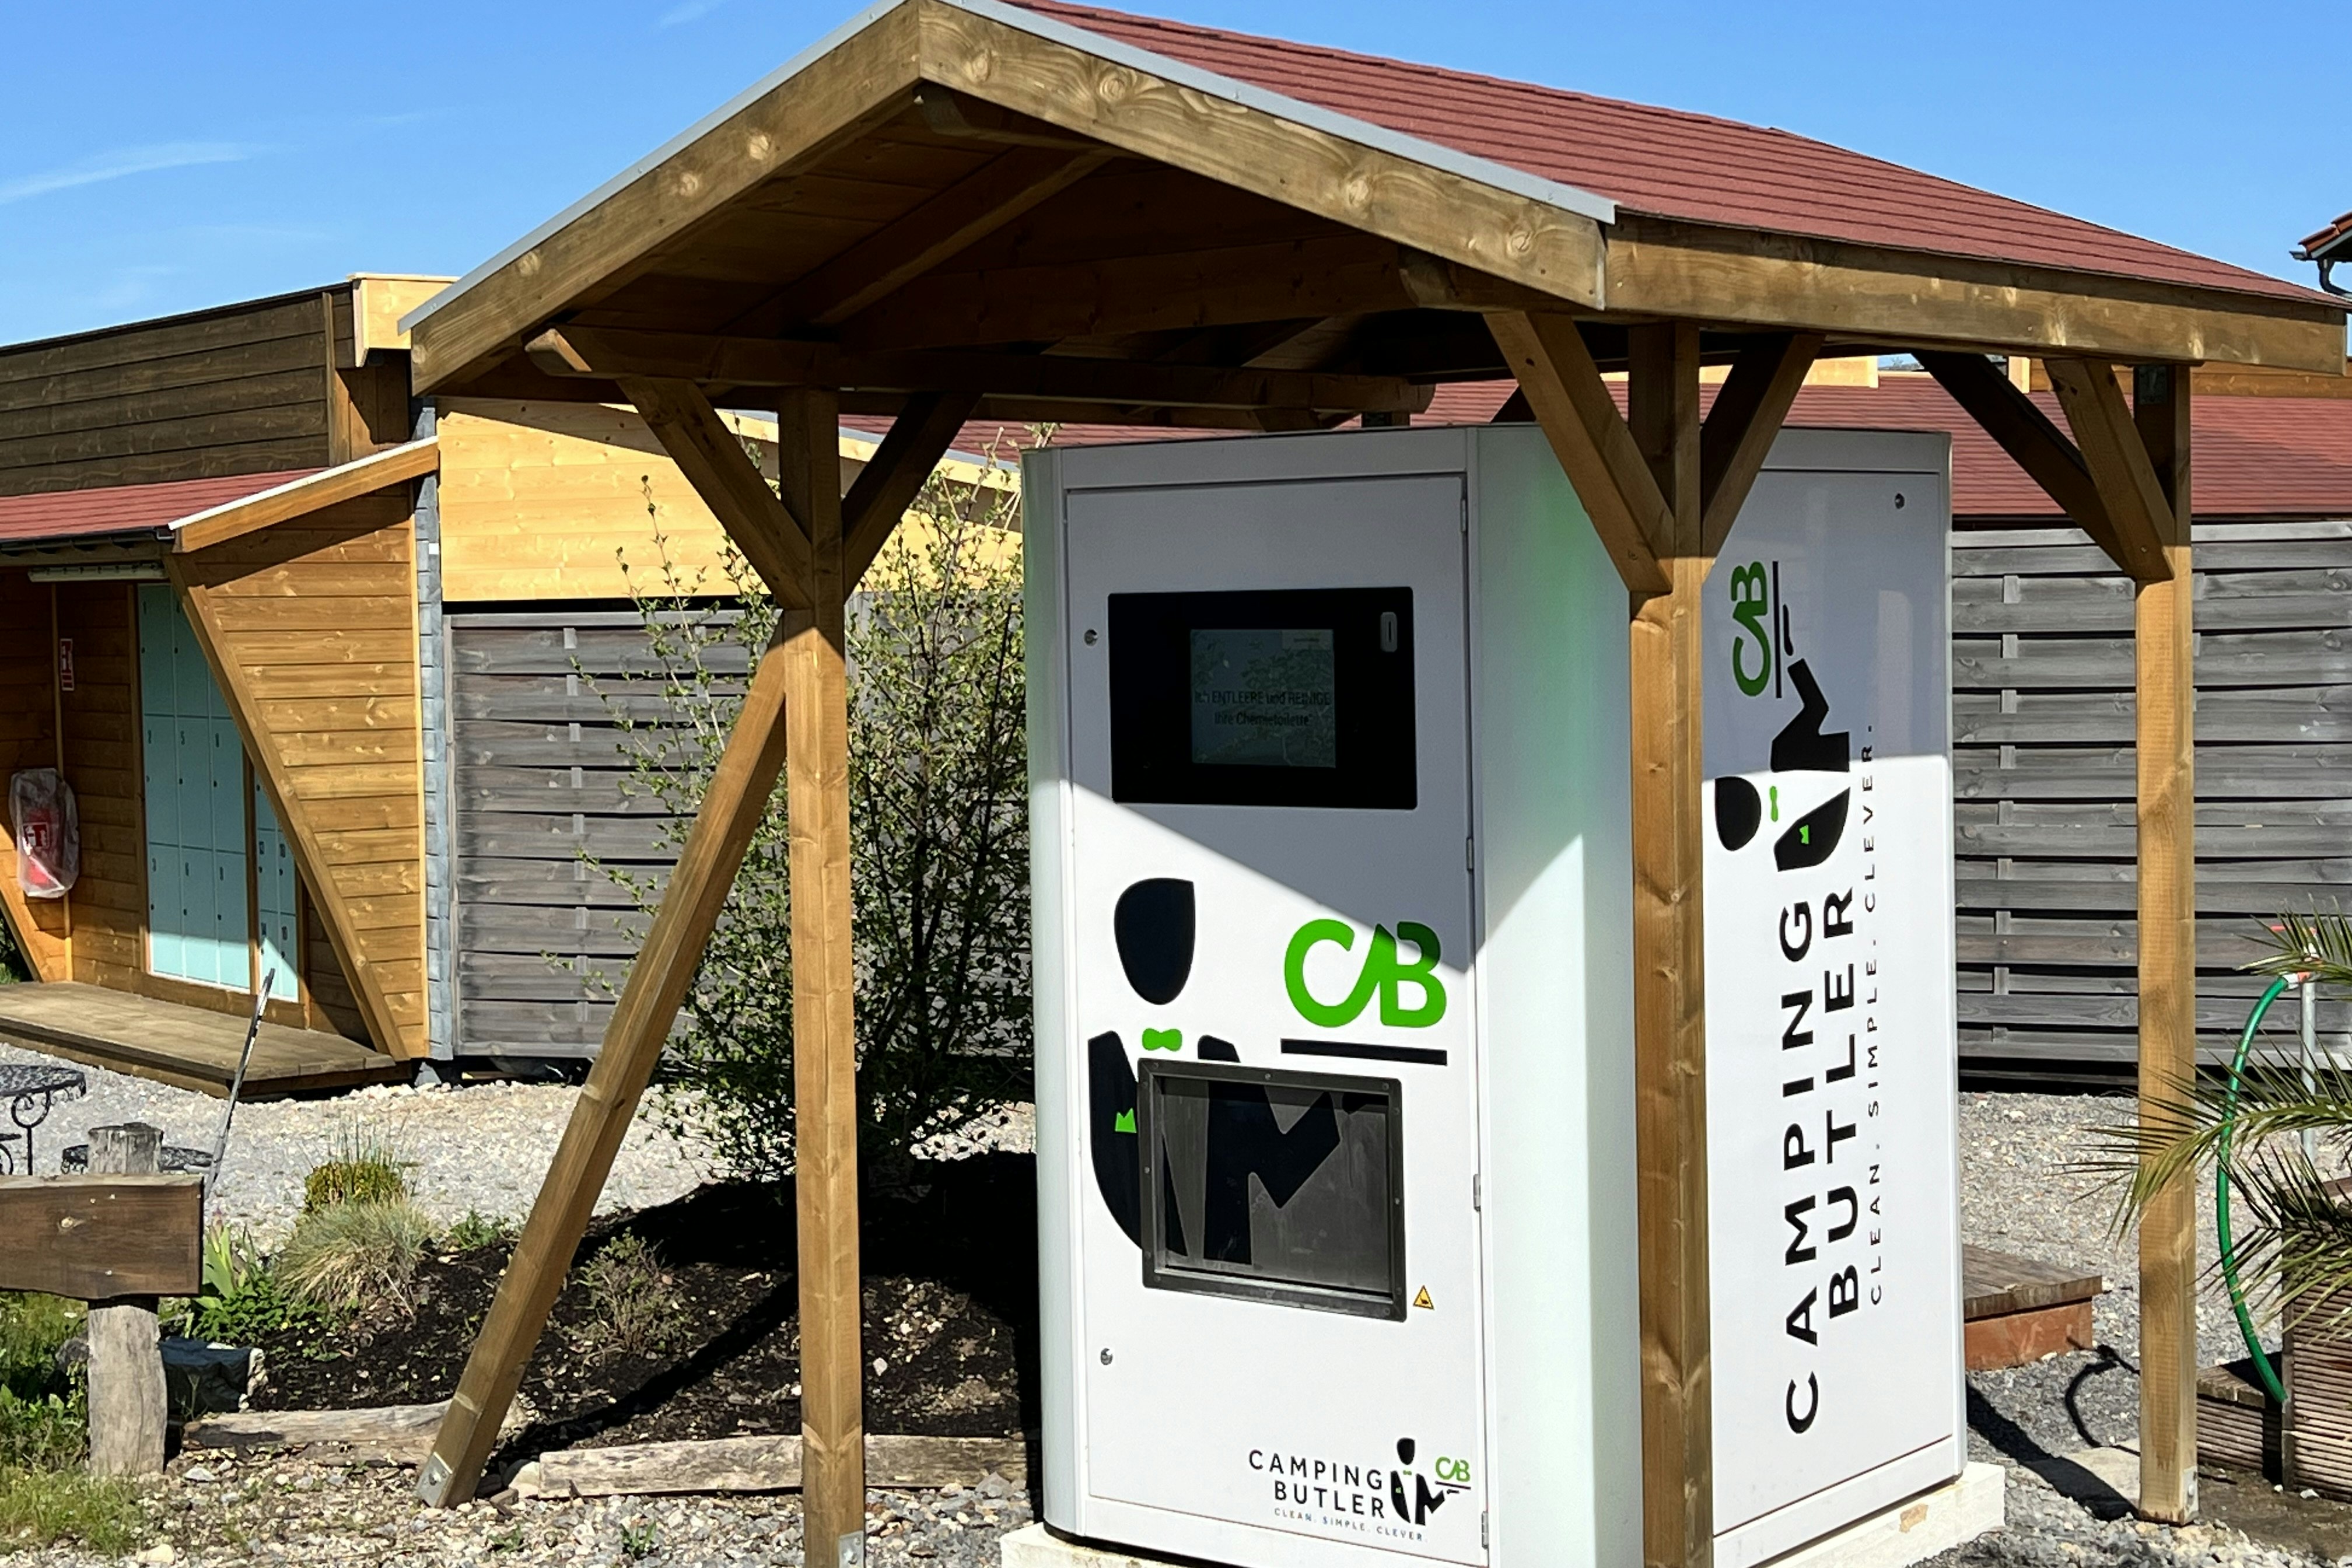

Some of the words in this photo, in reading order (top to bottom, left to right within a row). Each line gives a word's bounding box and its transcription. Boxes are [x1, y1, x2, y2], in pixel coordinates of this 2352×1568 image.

[1730, 561, 1771, 697] CB
[1212, 691, 1263, 705] ENTLEERE
[1861, 725, 1876, 913] CLEVER.
[1284, 919, 1447, 1028] CB
[1866, 940, 1880, 1118] SIMPLE.
[1779, 900, 1819, 1434] CAMPING
[1824, 887, 1859, 1319] BUTLER
[1869, 1143, 1882, 1305] CLEAN.
[1248, 1449, 1382, 1490] CAMPING
[1274, 1480, 1385, 1519] BUTLER
[1435, 1456, 1471, 1482] CB
